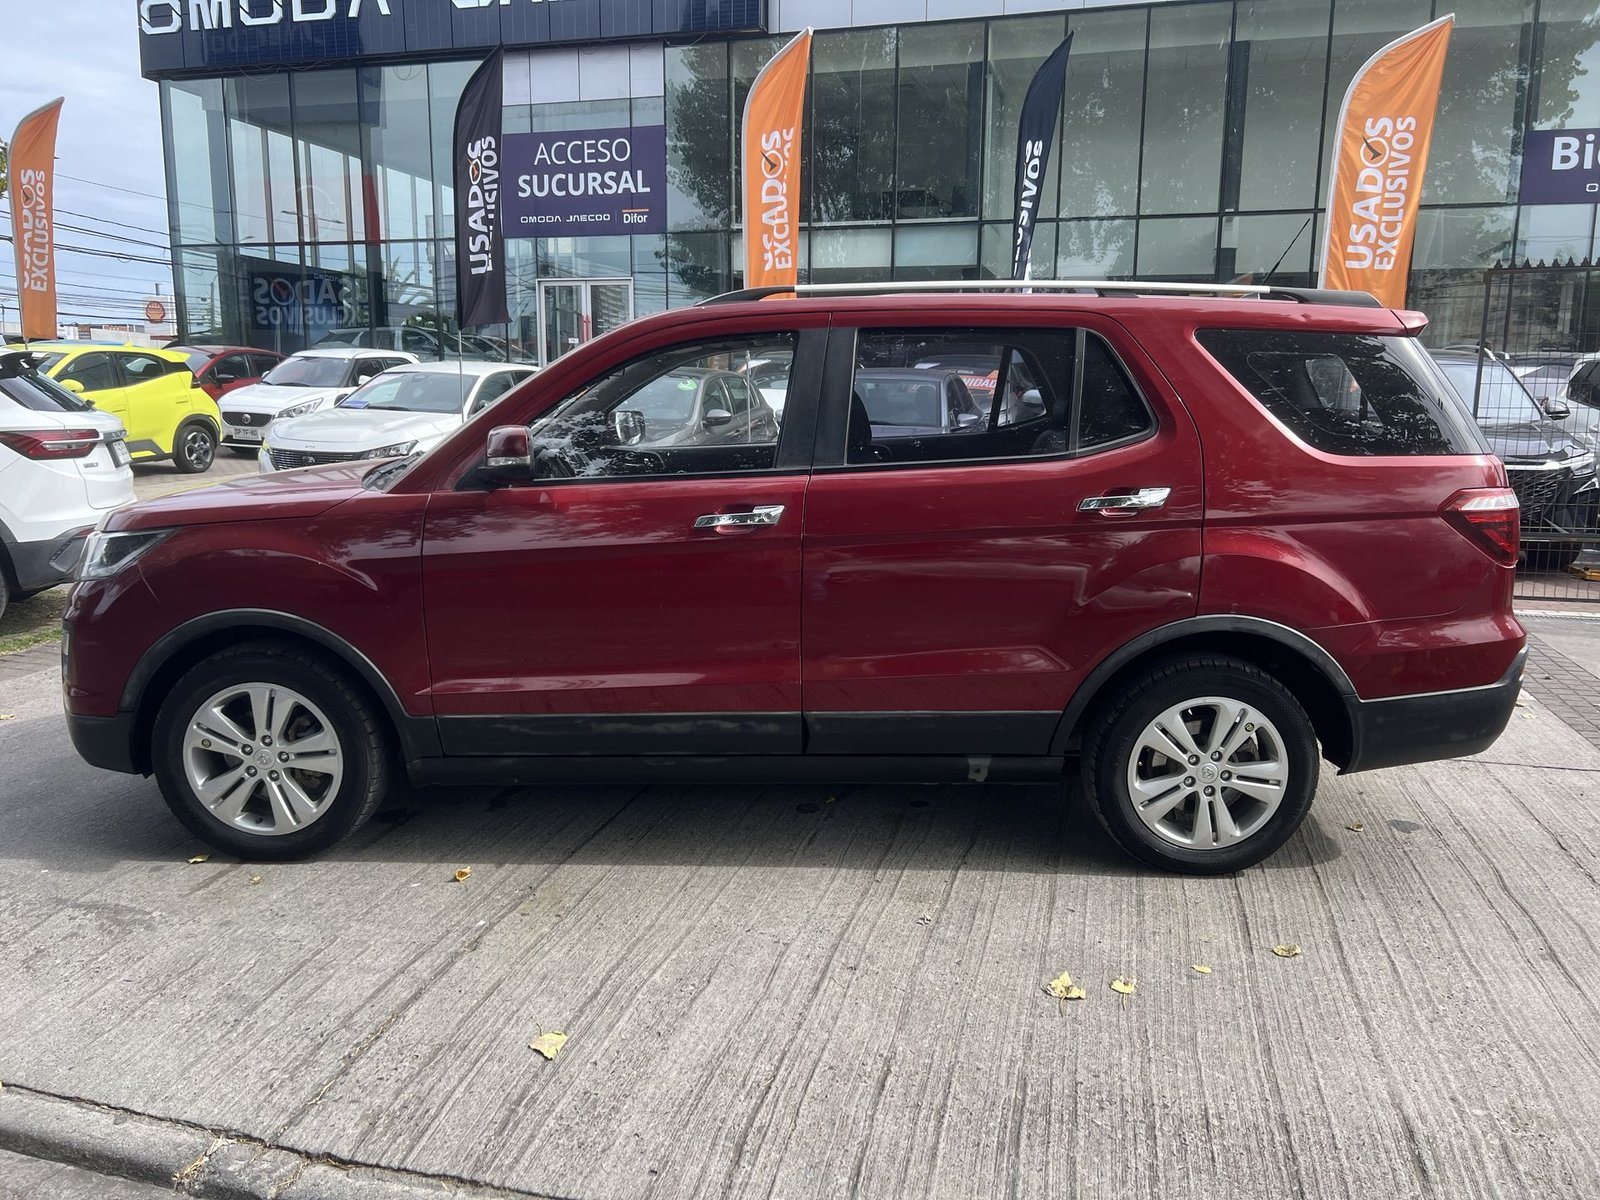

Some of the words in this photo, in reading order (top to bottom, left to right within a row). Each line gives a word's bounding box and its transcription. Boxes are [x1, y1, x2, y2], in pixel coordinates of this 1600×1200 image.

[467, 140, 490, 275] USADOS
[481, 136, 499, 271] SIVOS
[517, 169, 651, 198] SUCURSAL
[534, 138, 631, 165] ACCESO
[1345, 117, 1394, 270] USADOS
[1374, 116, 1417, 270] EXCLUSIVOS
[1551, 133, 1600, 170] Bi
[30, 170, 49, 292] EXCLUSIVOS
[520, 215, 562, 224] OMODA
[566, 213, 611, 223] JAECOO
[623, 213, 648, 224] Difor
